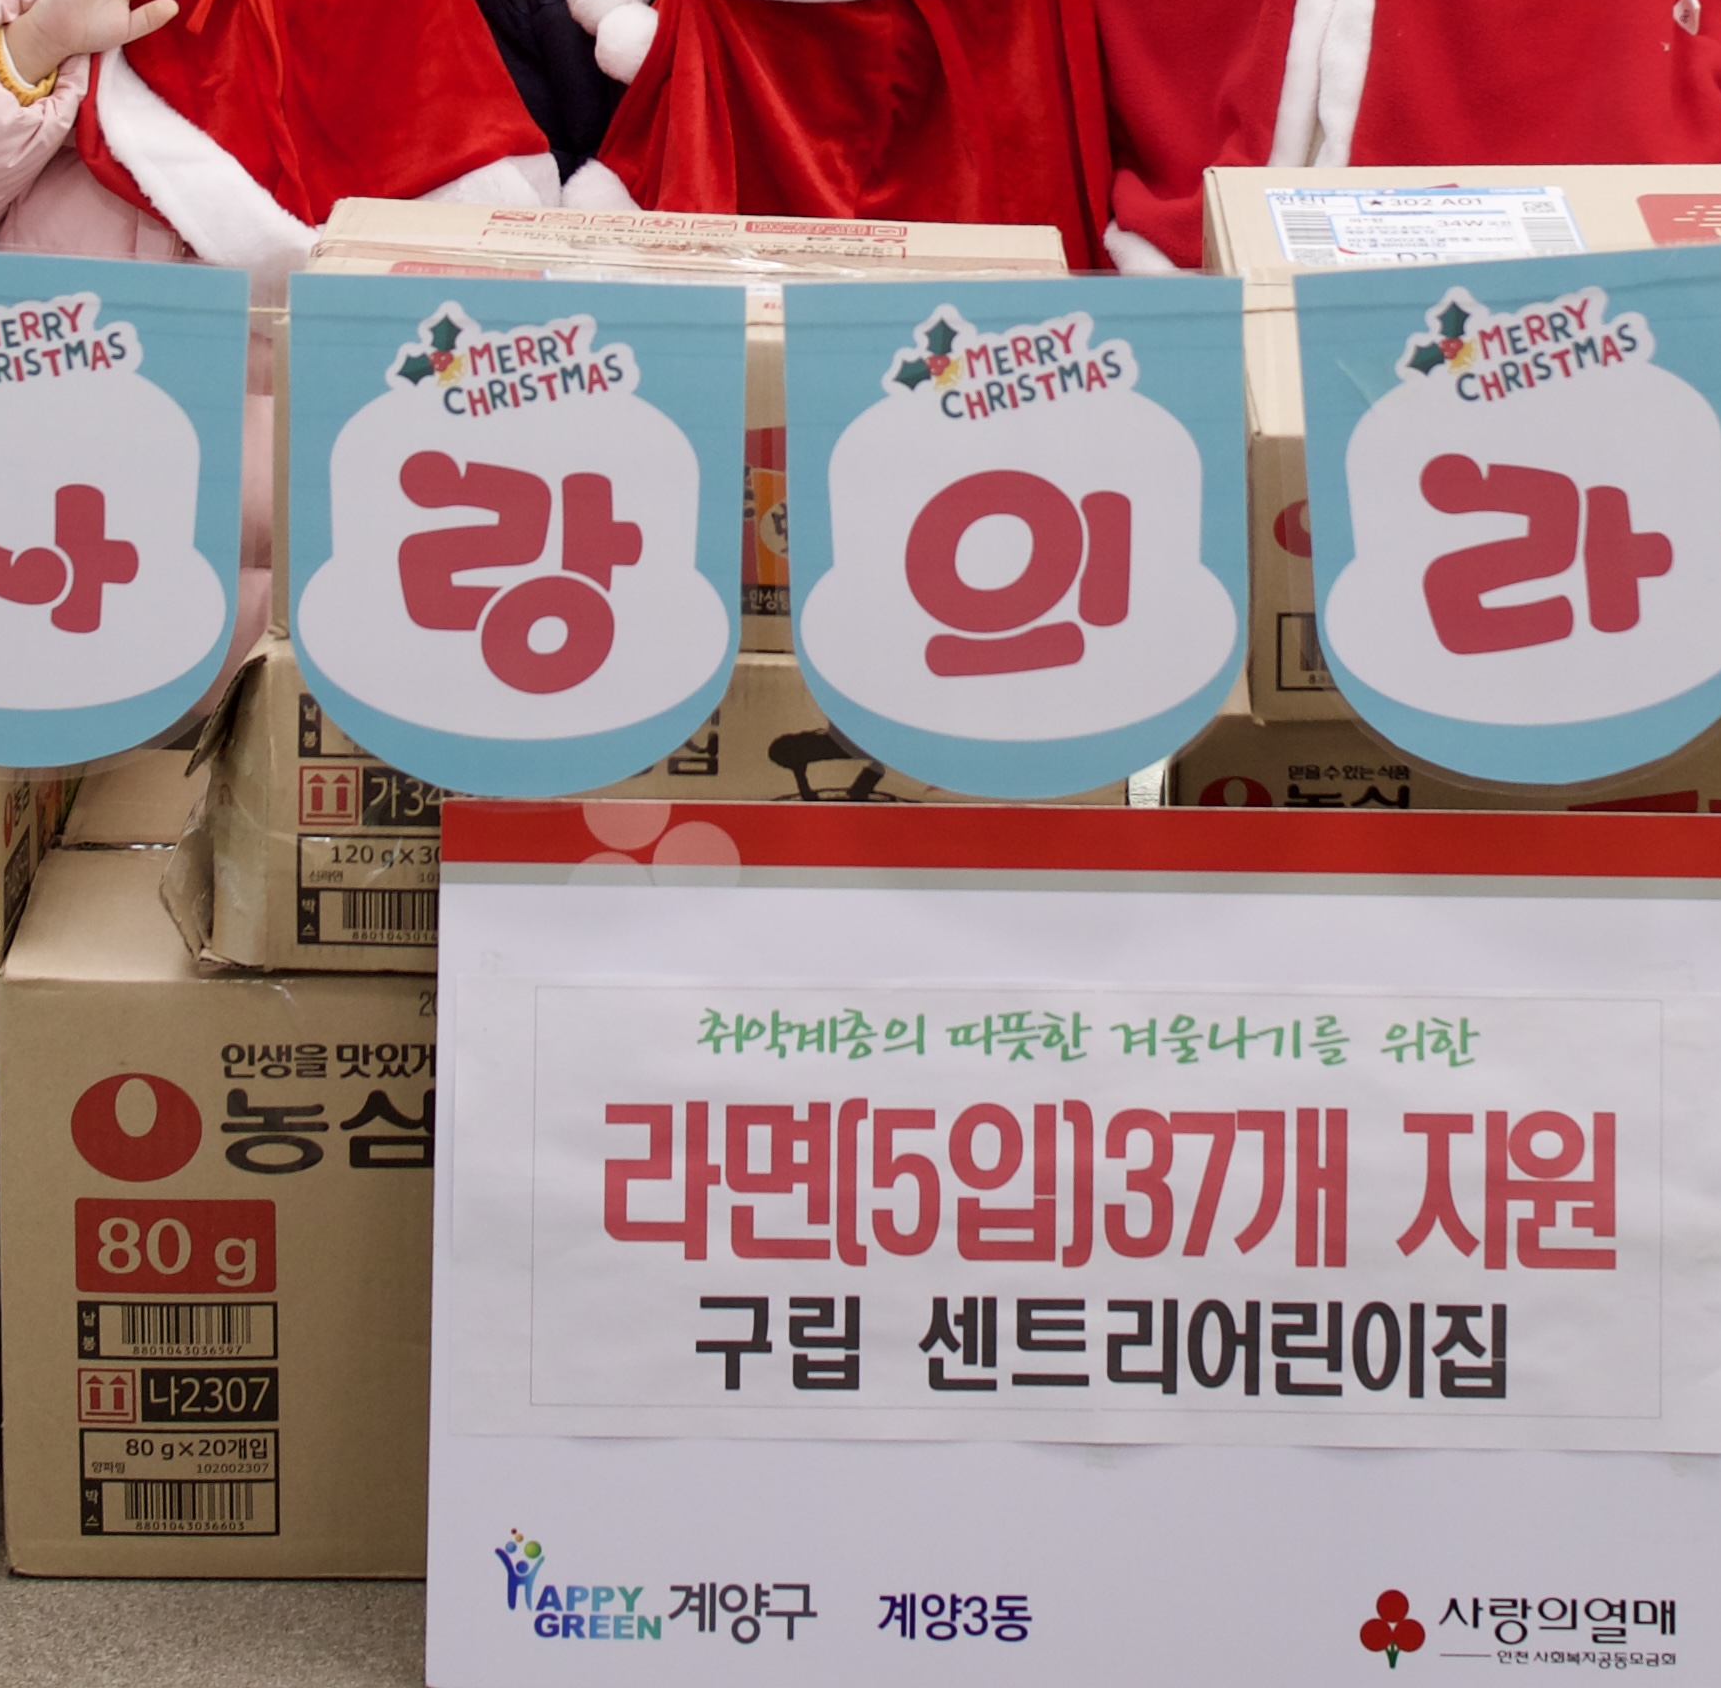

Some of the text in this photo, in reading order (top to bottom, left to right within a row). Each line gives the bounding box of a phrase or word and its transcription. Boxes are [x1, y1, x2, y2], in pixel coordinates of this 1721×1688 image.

[468, 325, 579, 377] MERRY
[964, 322, 1077, 380] MERRY
[1478, 298, 1591, 360] MERRY
[443, 353, 623, 418] CHRISTMAS
[941, 350, 1122, 420] CHRISTMAS
[1456, 322, 1638, 403] CHRISTMAS
[397, 448, 643, 695] 랑
[904, 469, 1133, 678] 의
[1419, 452, 1673, 656] 라
[331, 845, 374, 865] 120
[221, 1043, 328, 1079] 인생을
[695, 1006, 1482, 1068] 취약계층의 따뜻한 겨울나기를 위한
[220, 1087, 435, 1175] 농심
[1396, 1111, 1619, 1271] 지원
[97, 1217, 257, 1288] 80 g
[695, 1295, 1509, 1400] 구립 센트리어린이집
[149, 1375, 271, 1416] 나2307
[125, 1438, 154, 1457] 80
[196, 1462, 270, 1475] 102002307
[534, 1613, 662, 1640] GREEN
[668, 1582, 819, 1646] 계양구
[877, 1592, 1033, 1643] 계양3동
[1439, 1597, 1677, 1646] 사랑의열매
[1496, 1649, 1677, 1670] 인천 사회복지공동모금회
